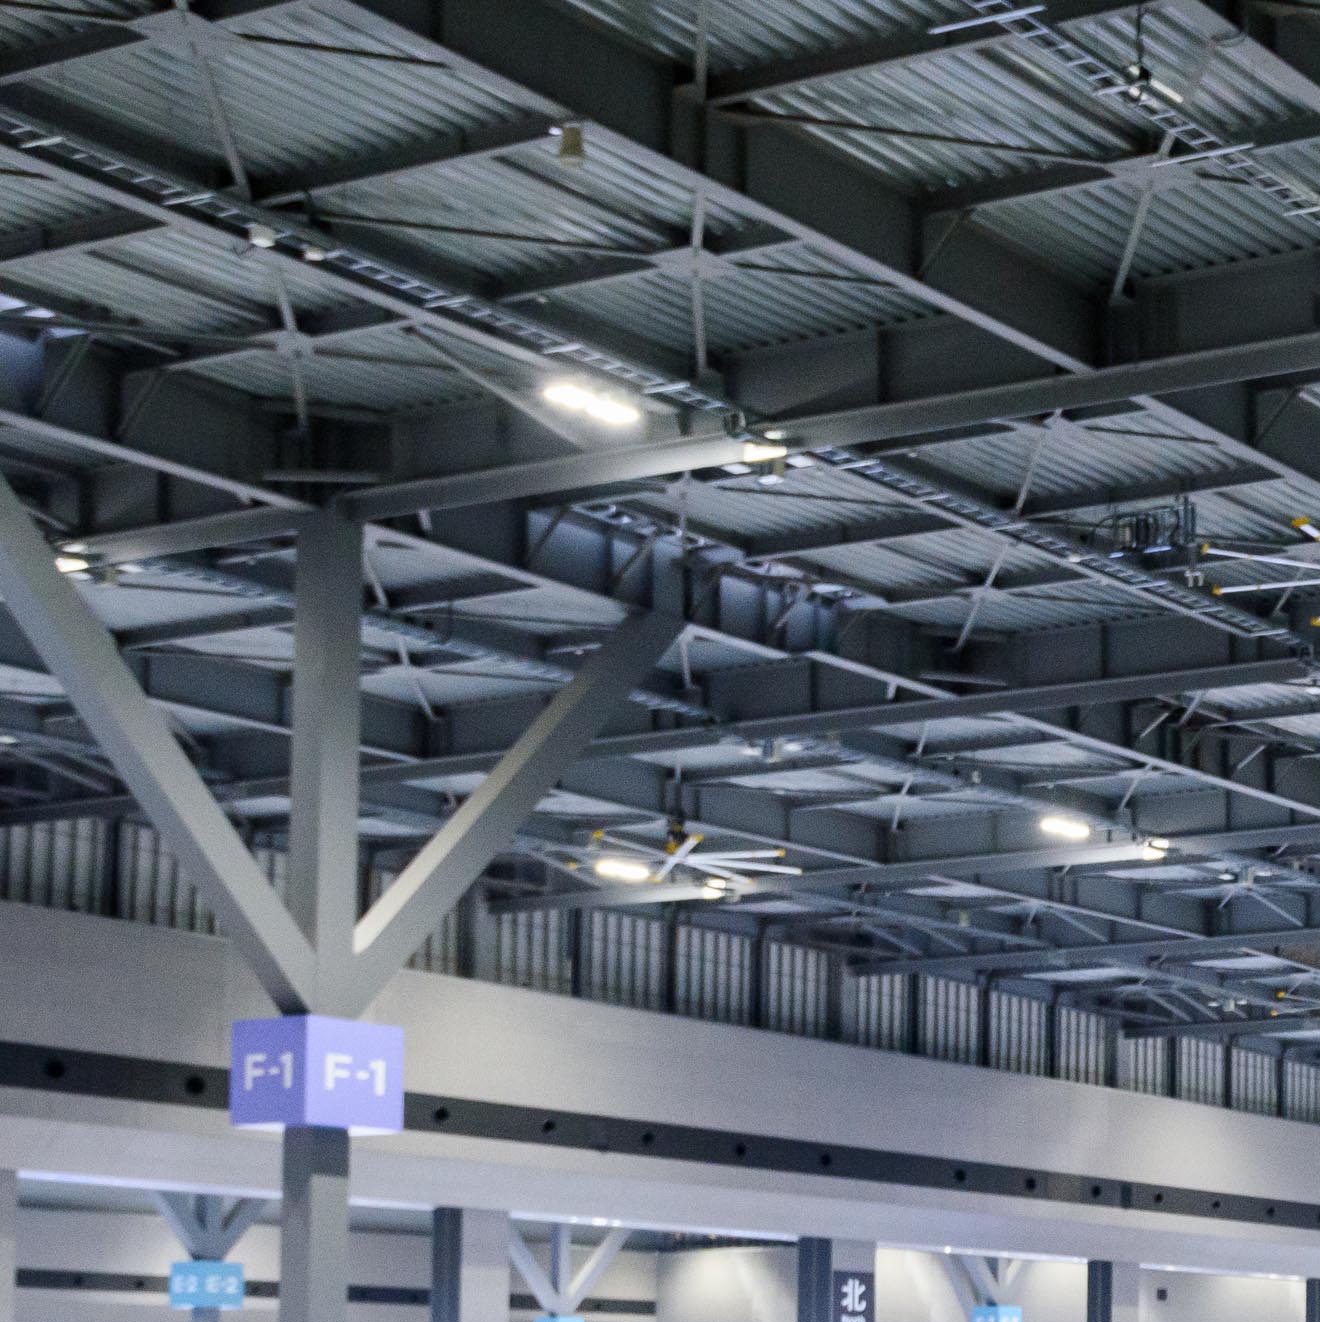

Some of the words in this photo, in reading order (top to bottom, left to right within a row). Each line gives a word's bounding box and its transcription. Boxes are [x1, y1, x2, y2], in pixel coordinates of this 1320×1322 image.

[245, 1052, 293, 1090] F-1
[325, 1054, 387, 1096] F-1
[841, 1278, 867, 1312] 北
